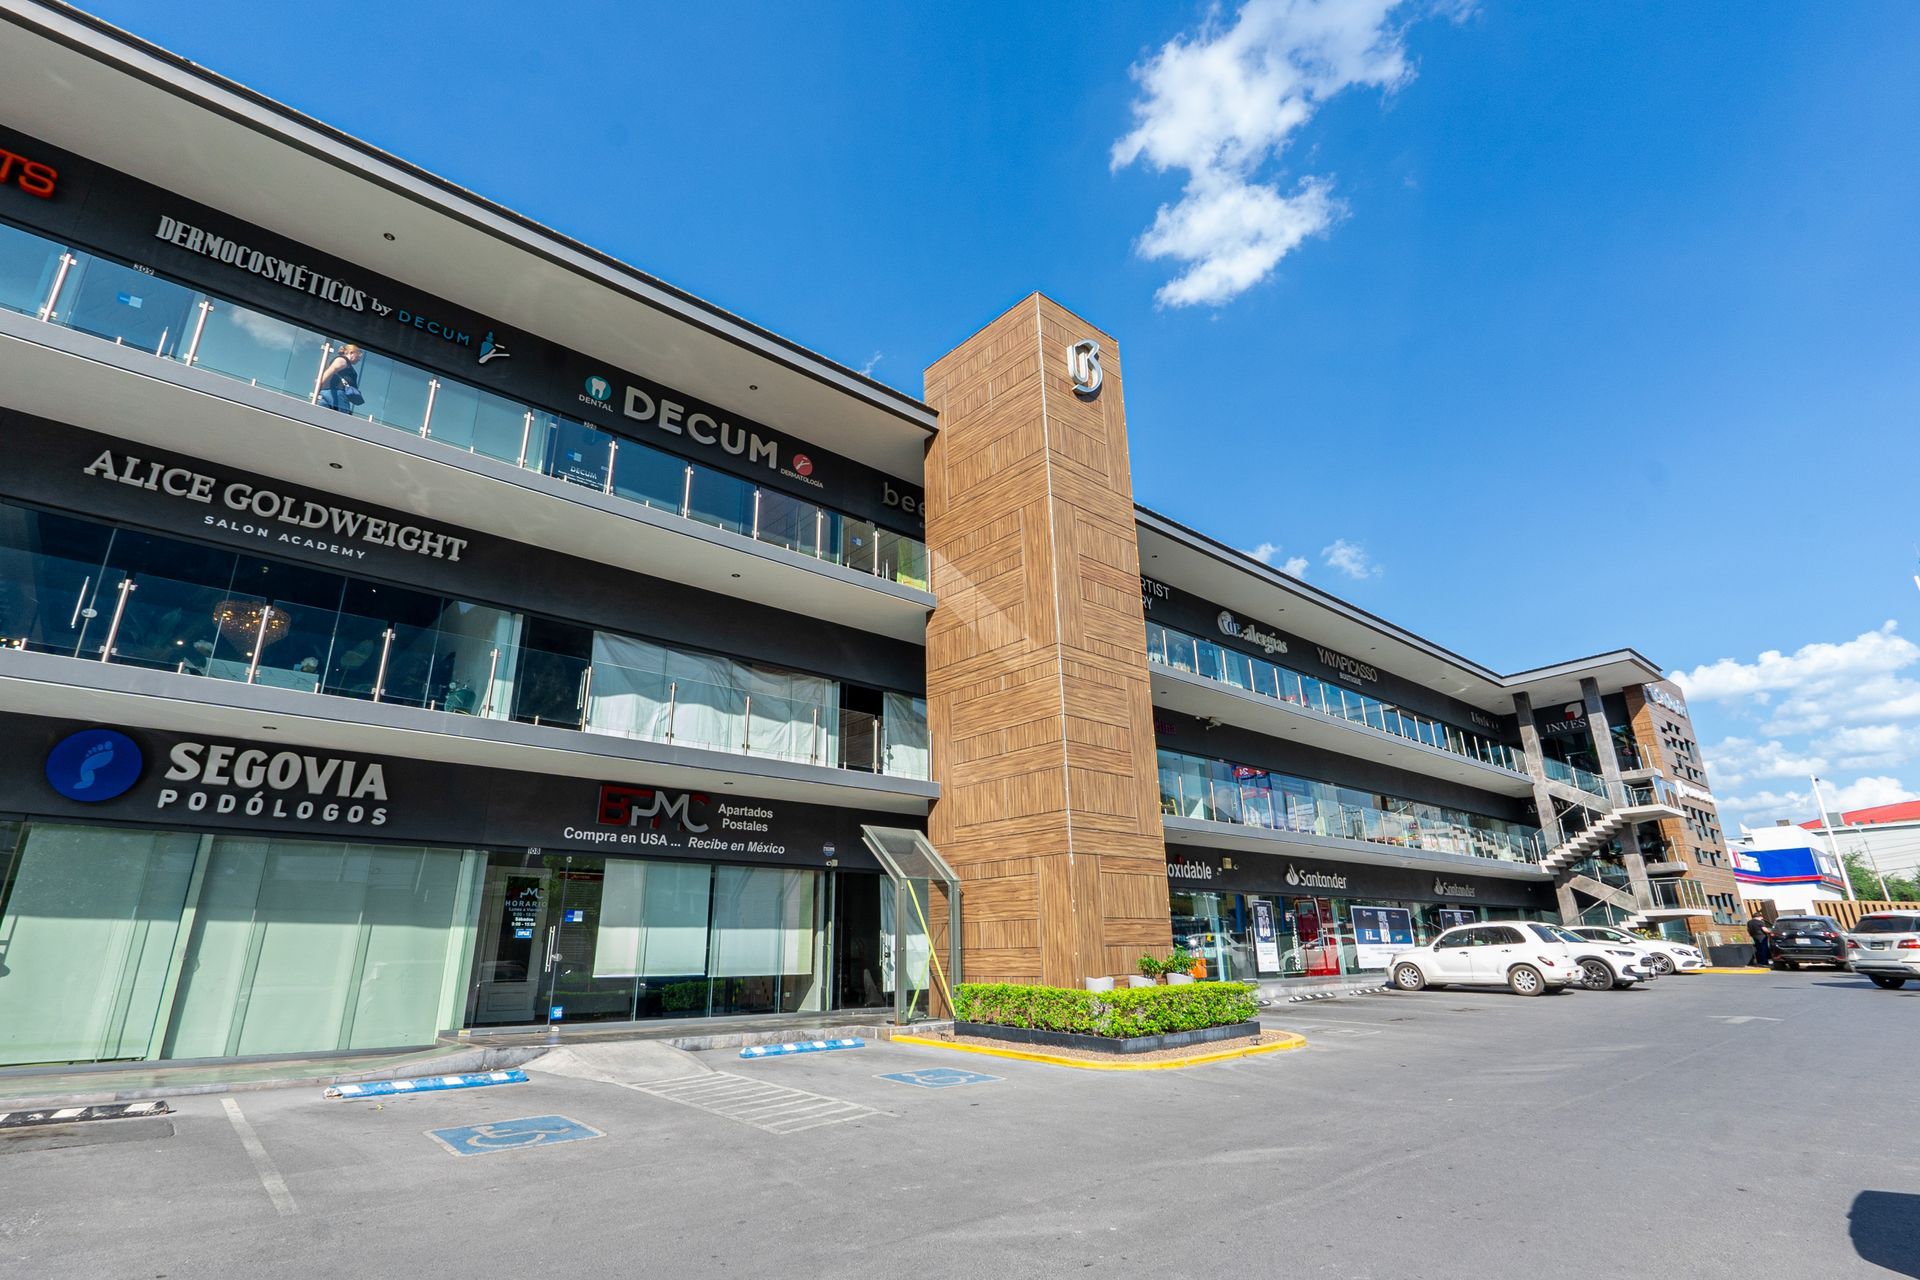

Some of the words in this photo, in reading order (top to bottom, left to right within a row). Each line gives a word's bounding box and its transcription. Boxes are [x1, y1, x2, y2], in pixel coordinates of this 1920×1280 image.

[155, 214, 366, 312] DERMOCOSMÉTICOS
[371, 298, 393, 317] by
[398, 309, 470, 346] DECUM
[579, 393, 613, 412] DENTAL
[623, 385, 777, 470] DECUM
[780, 467, 824, 489] DERMATOLOGÍA
[83, 449, 216, 504] ALICE
[223, 483, 468, 562] GOLDWEIGHT
[204, 515, 269, 537] SALON
[278, 532, 366, 559] ACADEMY
[1316, 646, 1378, 682] YAYAPICASSO
[164, 742, 388, 801] SEGOVIA
[157, 789, 387, 826] PODÓLOGOS
[718, 803, 774, 819] Apartados
[722, 818, 768, 832] Postales
[563, 826, 617, 844] Compra
[621, 833, 637, 844] en
[640, 832, 668, 847] USA
[688, 836, 728, 851] Recibe
[731, 841, 745, 852] en
[747, 840, 785, 854] México
[1167, 860, 1212, 880] oxidable
[1300, 869, 1347, 889] Santander
[1443, 881, 1475, 897] Santander
[505, 900, 548, 908] HORARIO
